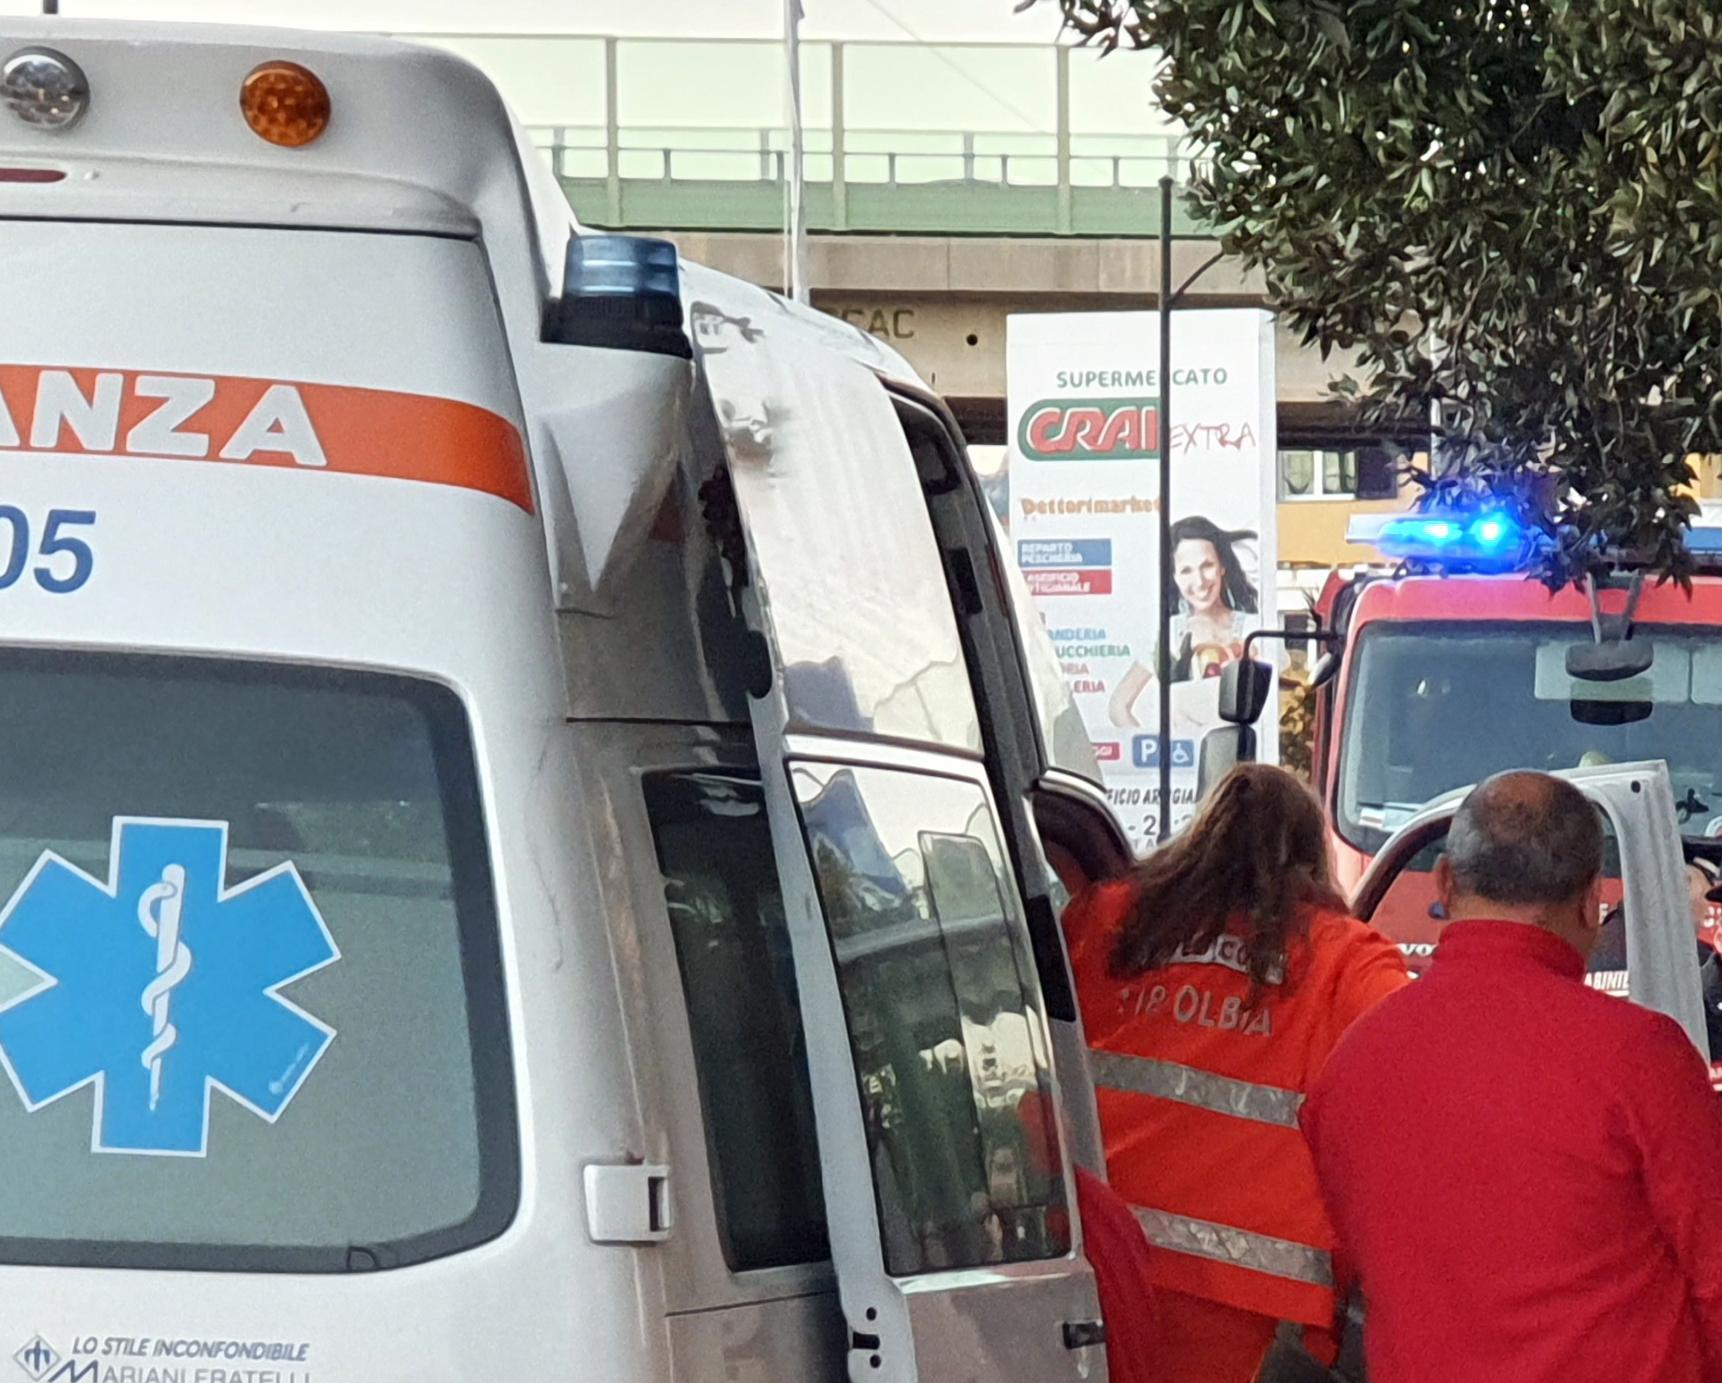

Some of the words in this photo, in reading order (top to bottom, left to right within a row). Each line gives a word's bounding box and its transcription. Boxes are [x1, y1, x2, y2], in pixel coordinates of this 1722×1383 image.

[1057, 368, 1228, 388] SUPERMECATO
[0, 369, 327, 467] NZA
[1055, 645, 1131, 659] UCCHIERIA
[72, 1337, 98, 1355] LO
[102, 1337, 150, 1357] STILE
[152, 1339, 310, 1361] INCONFONDIBILE
